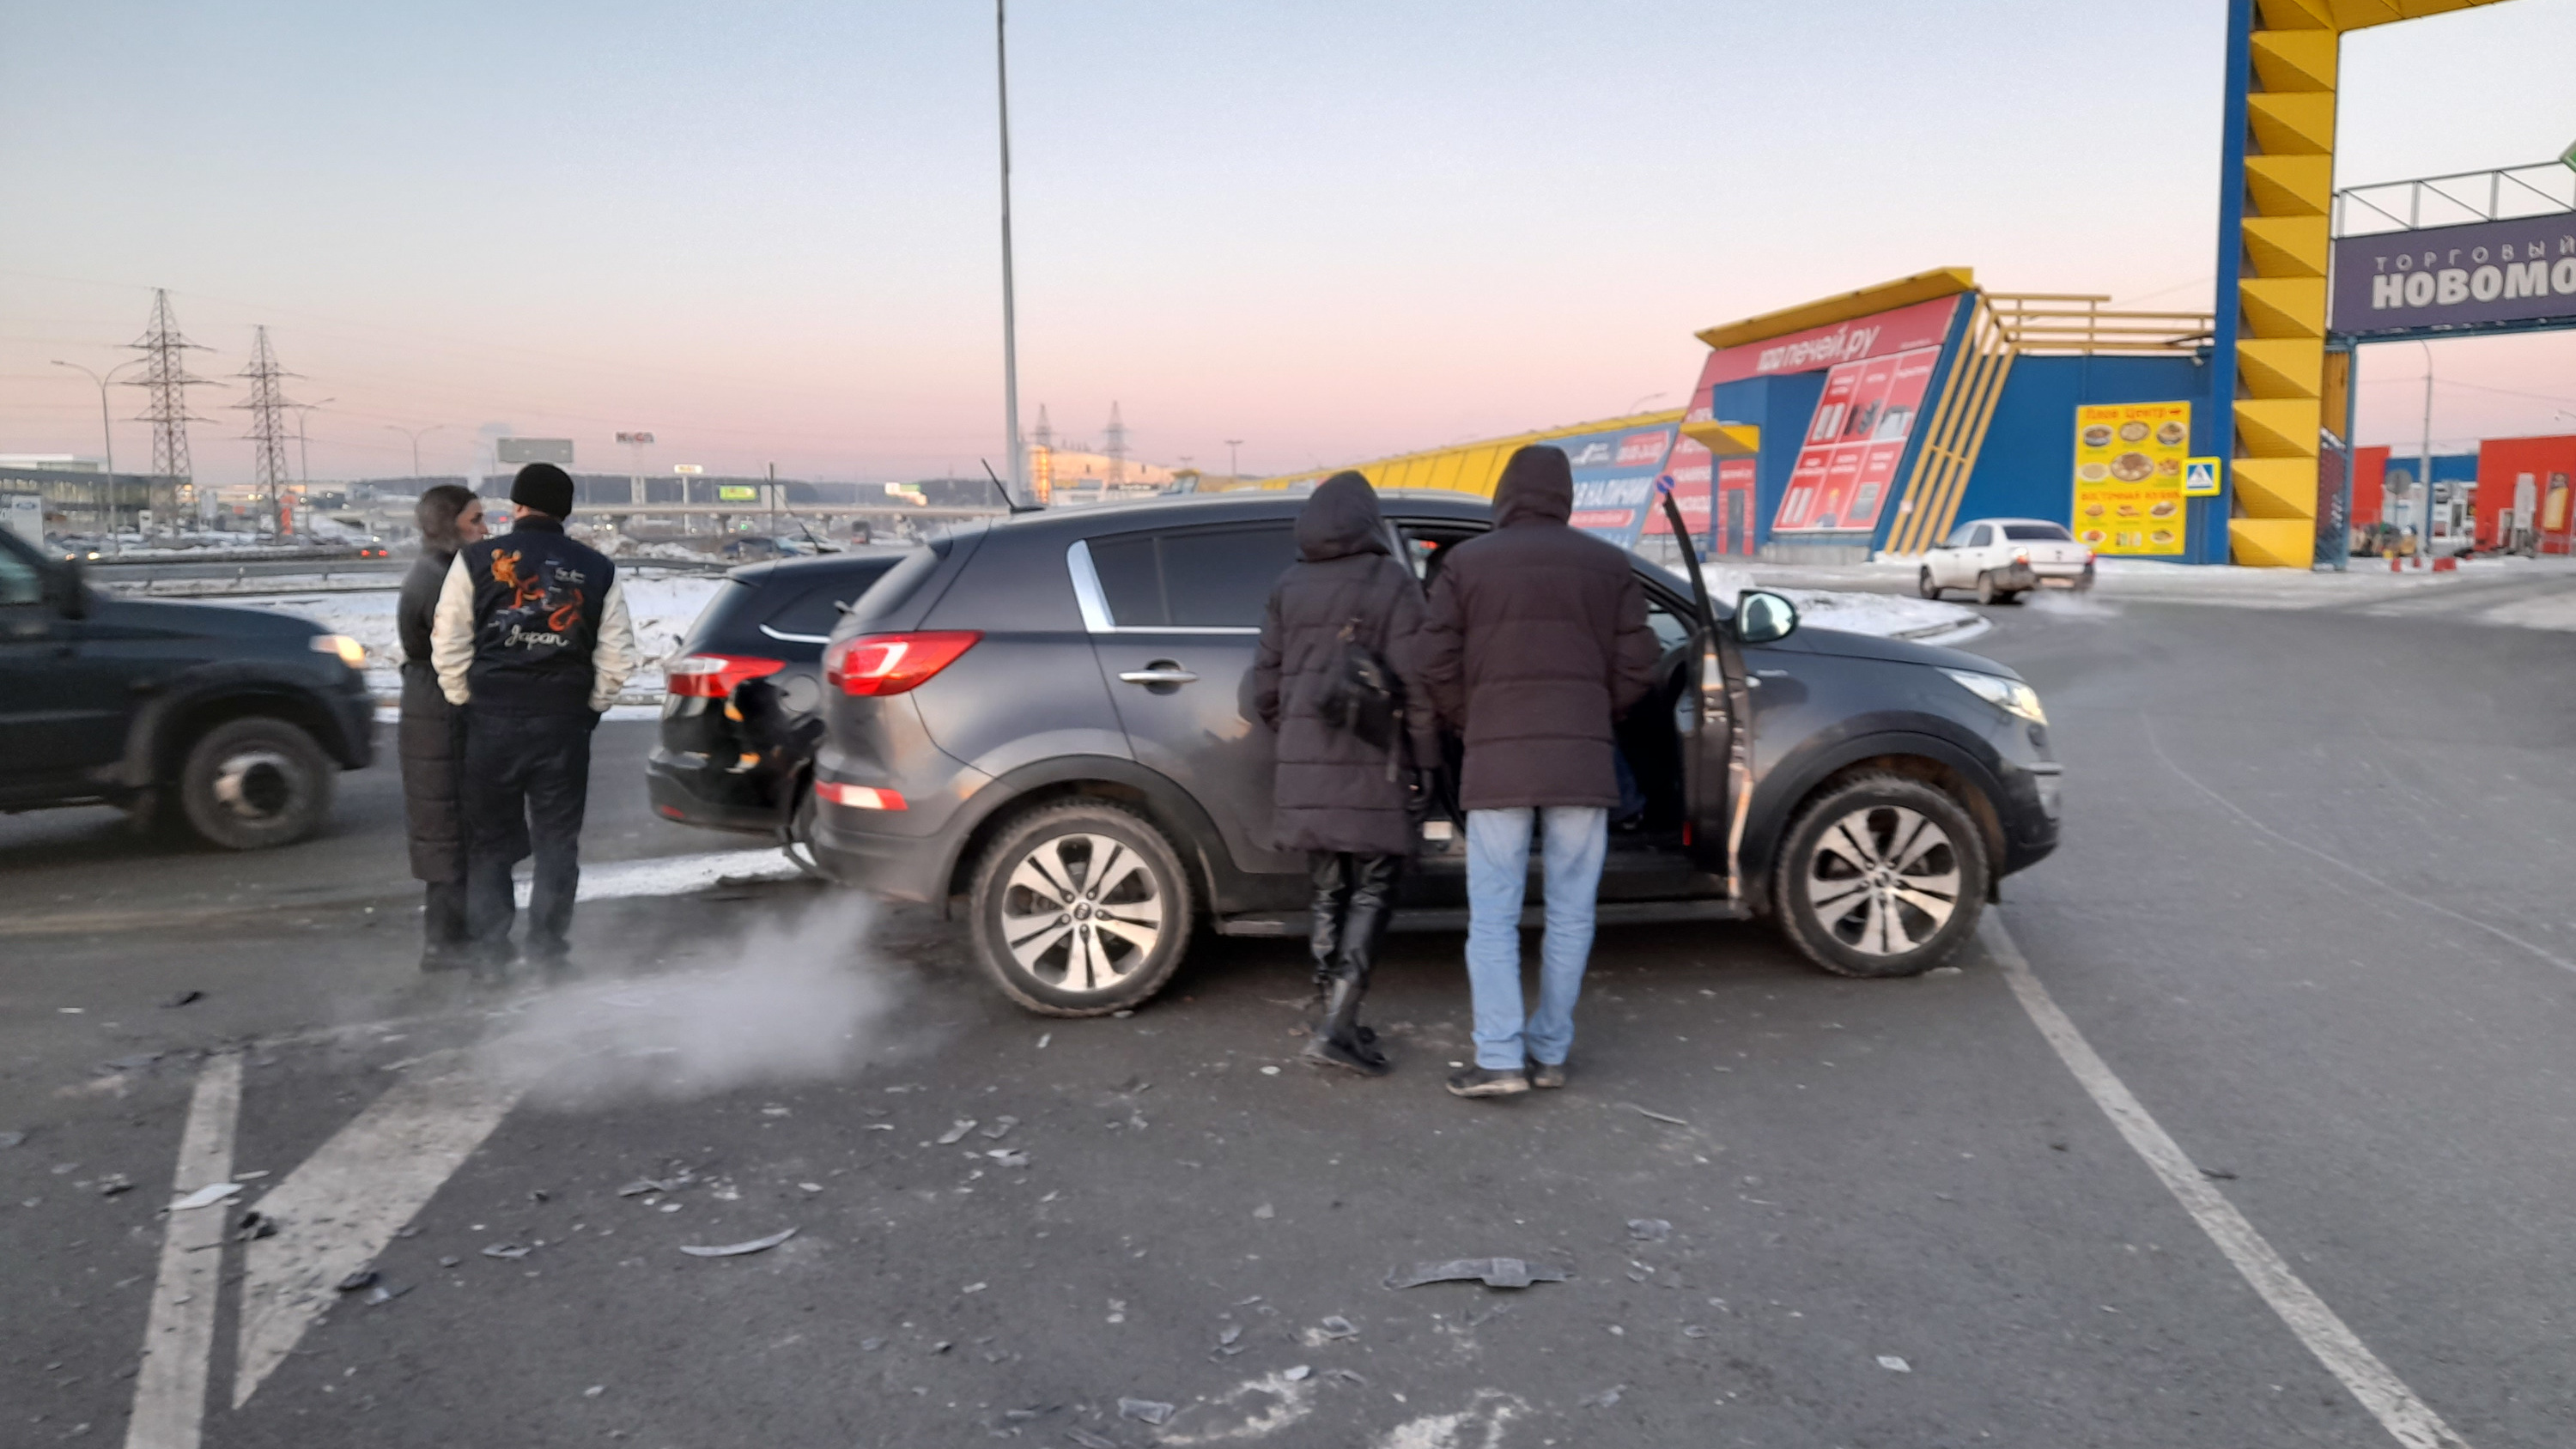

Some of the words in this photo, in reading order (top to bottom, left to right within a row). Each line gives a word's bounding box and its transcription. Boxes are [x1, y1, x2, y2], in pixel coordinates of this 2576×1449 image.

[2375, 234, 2575, 272] ТОРГОВЫЙ
[2371, 257, 2576, 310] НОВОМО
[504, 624, 569, 650] Japan
